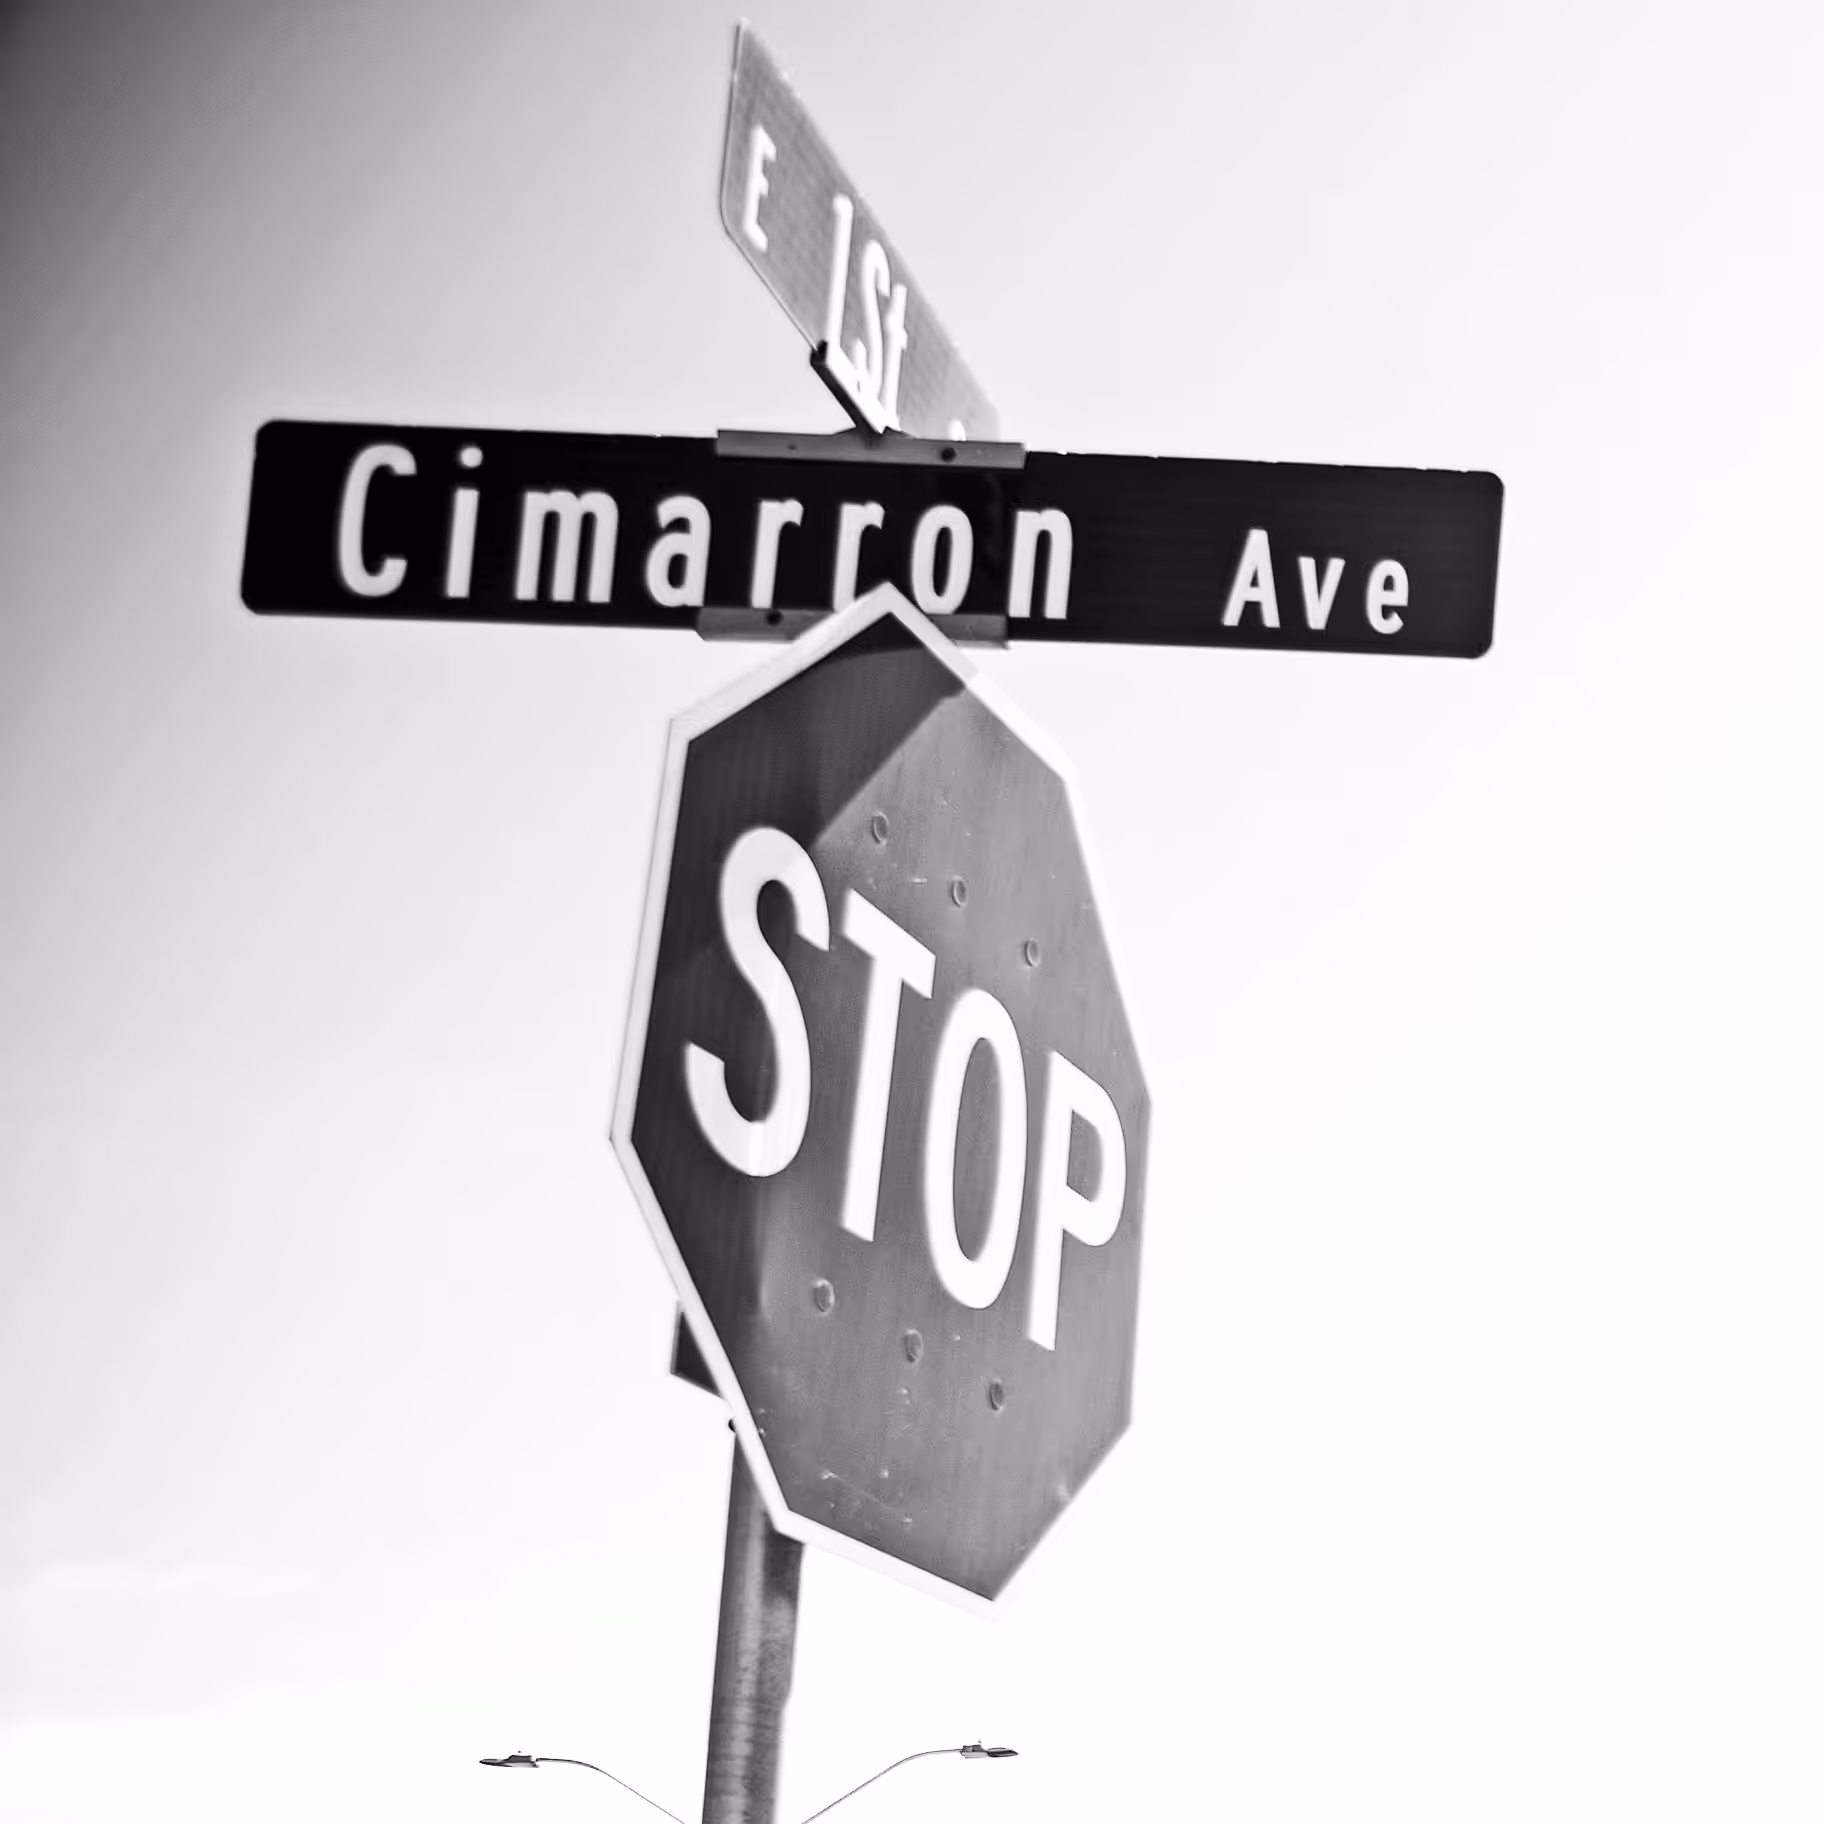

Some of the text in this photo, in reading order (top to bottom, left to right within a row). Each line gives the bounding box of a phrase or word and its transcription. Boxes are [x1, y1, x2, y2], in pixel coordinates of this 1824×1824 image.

[744, 124, 777, 253] E
[336, 442, 1411, 636] Cimarron Ave
[684, 825, 1128, 1352] STOP
